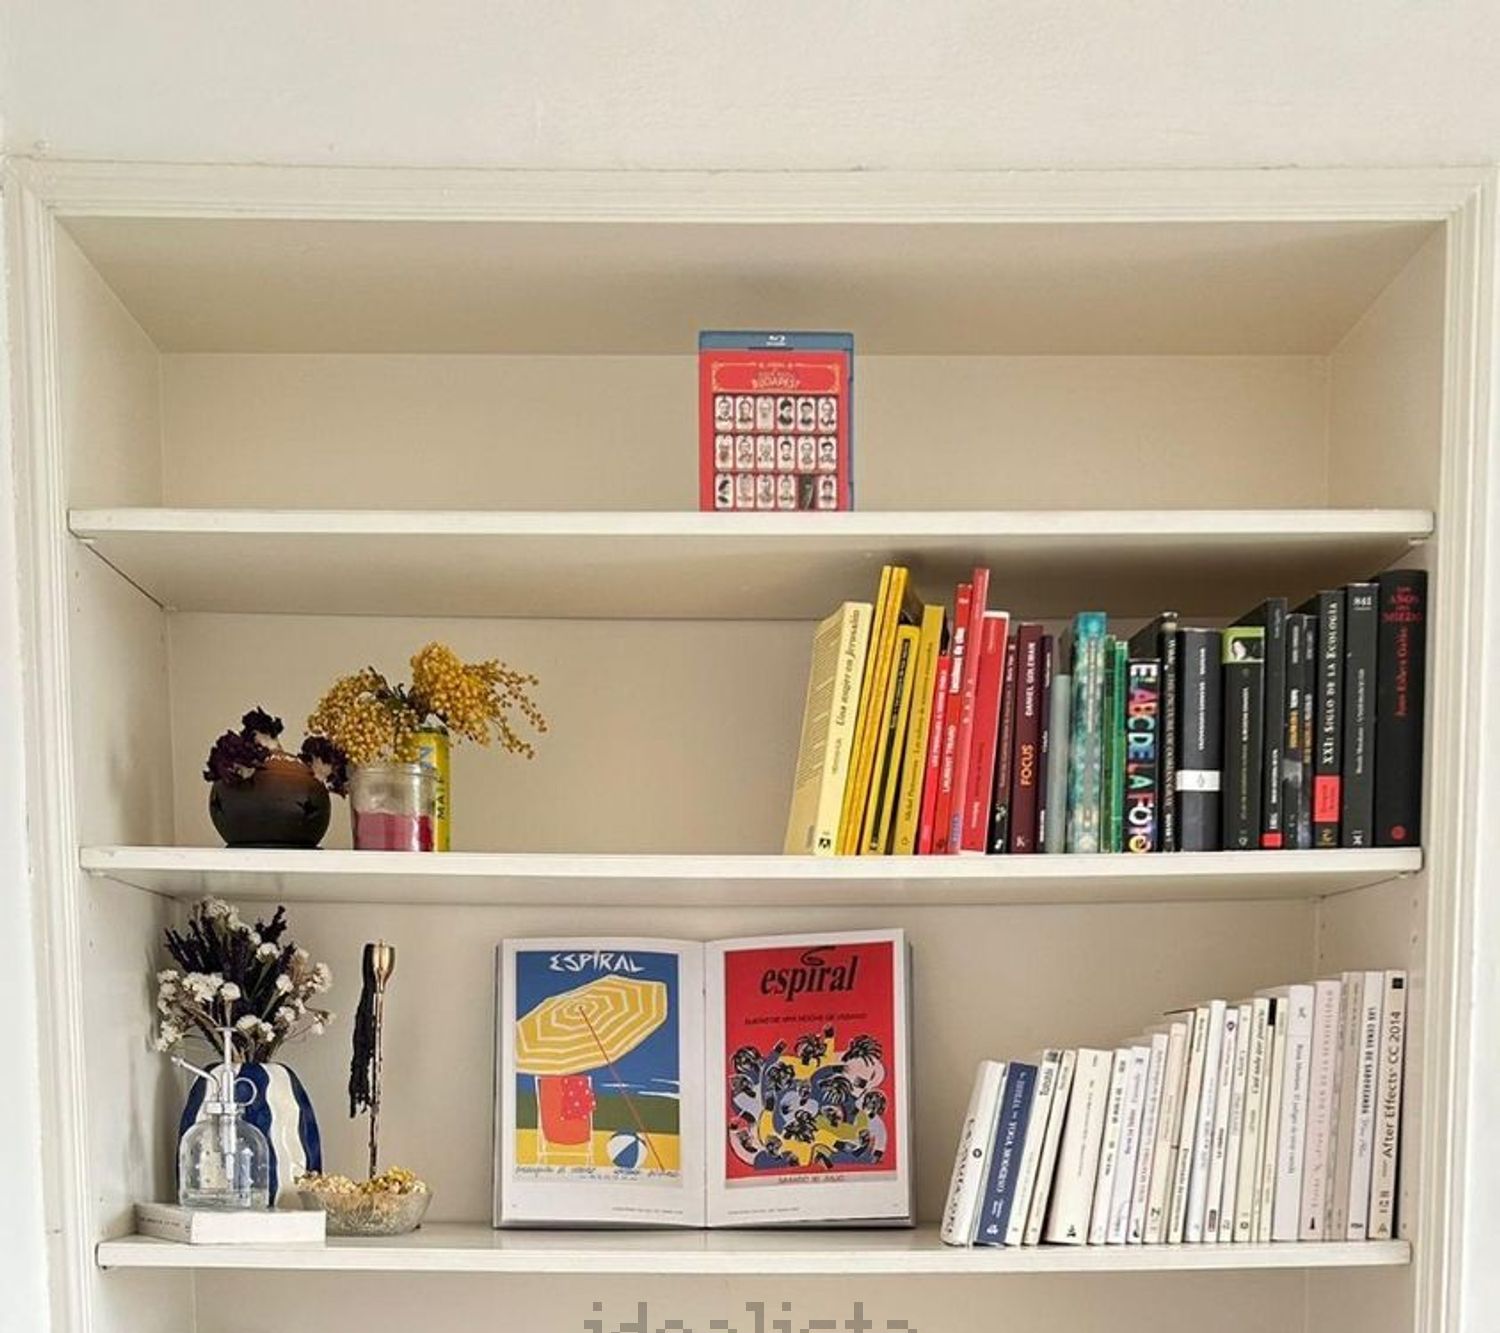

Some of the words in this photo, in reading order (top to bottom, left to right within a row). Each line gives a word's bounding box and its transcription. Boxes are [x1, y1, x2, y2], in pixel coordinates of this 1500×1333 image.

[1025, 641, 1036, 683] GOLEMAN
[1326, 662, 1337, 677] LA
[1024, 684, 1035, 716] DANIEL
[1326, 681, 1337, 695] DE
[1323, 698, 1337, 732] SIGLO
[1019, 743, 1034, 785] FOCUS
[548, 951, 646, 974] ESPIRAL
[760, 948, 859, 1003] espiral
[1389, 1010, 1402, 1042] 2014
[1389, 1043, 1401, 1065] CC
[1385, 1071, 1398, 1118] Effects
[1382, 1122, 1394, 1158] After
